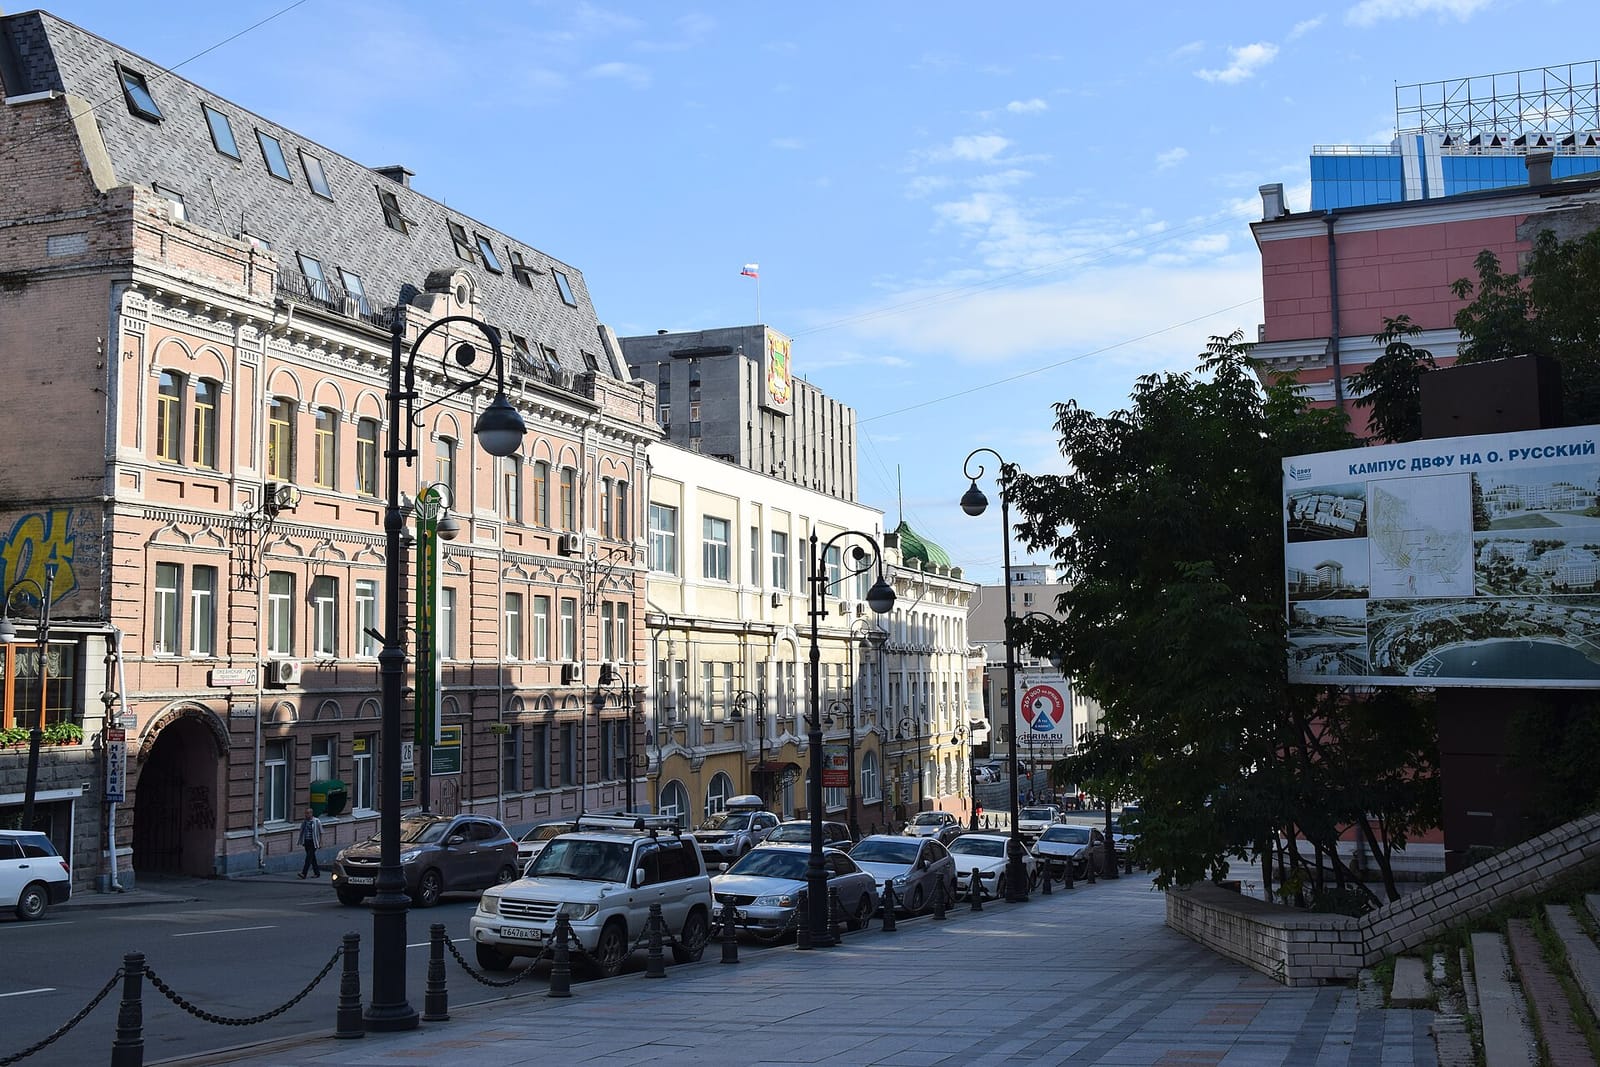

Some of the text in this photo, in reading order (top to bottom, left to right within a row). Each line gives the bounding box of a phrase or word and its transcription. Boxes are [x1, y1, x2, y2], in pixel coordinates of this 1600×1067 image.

[1349, 440, 1596, 475] КАМПУС ДВФУ НА О. РУССКИЙ
[246, 670, 256, 683] 26
[404, 745, 411, 760] 26
[110, 745, 118, 793] НАТАША
